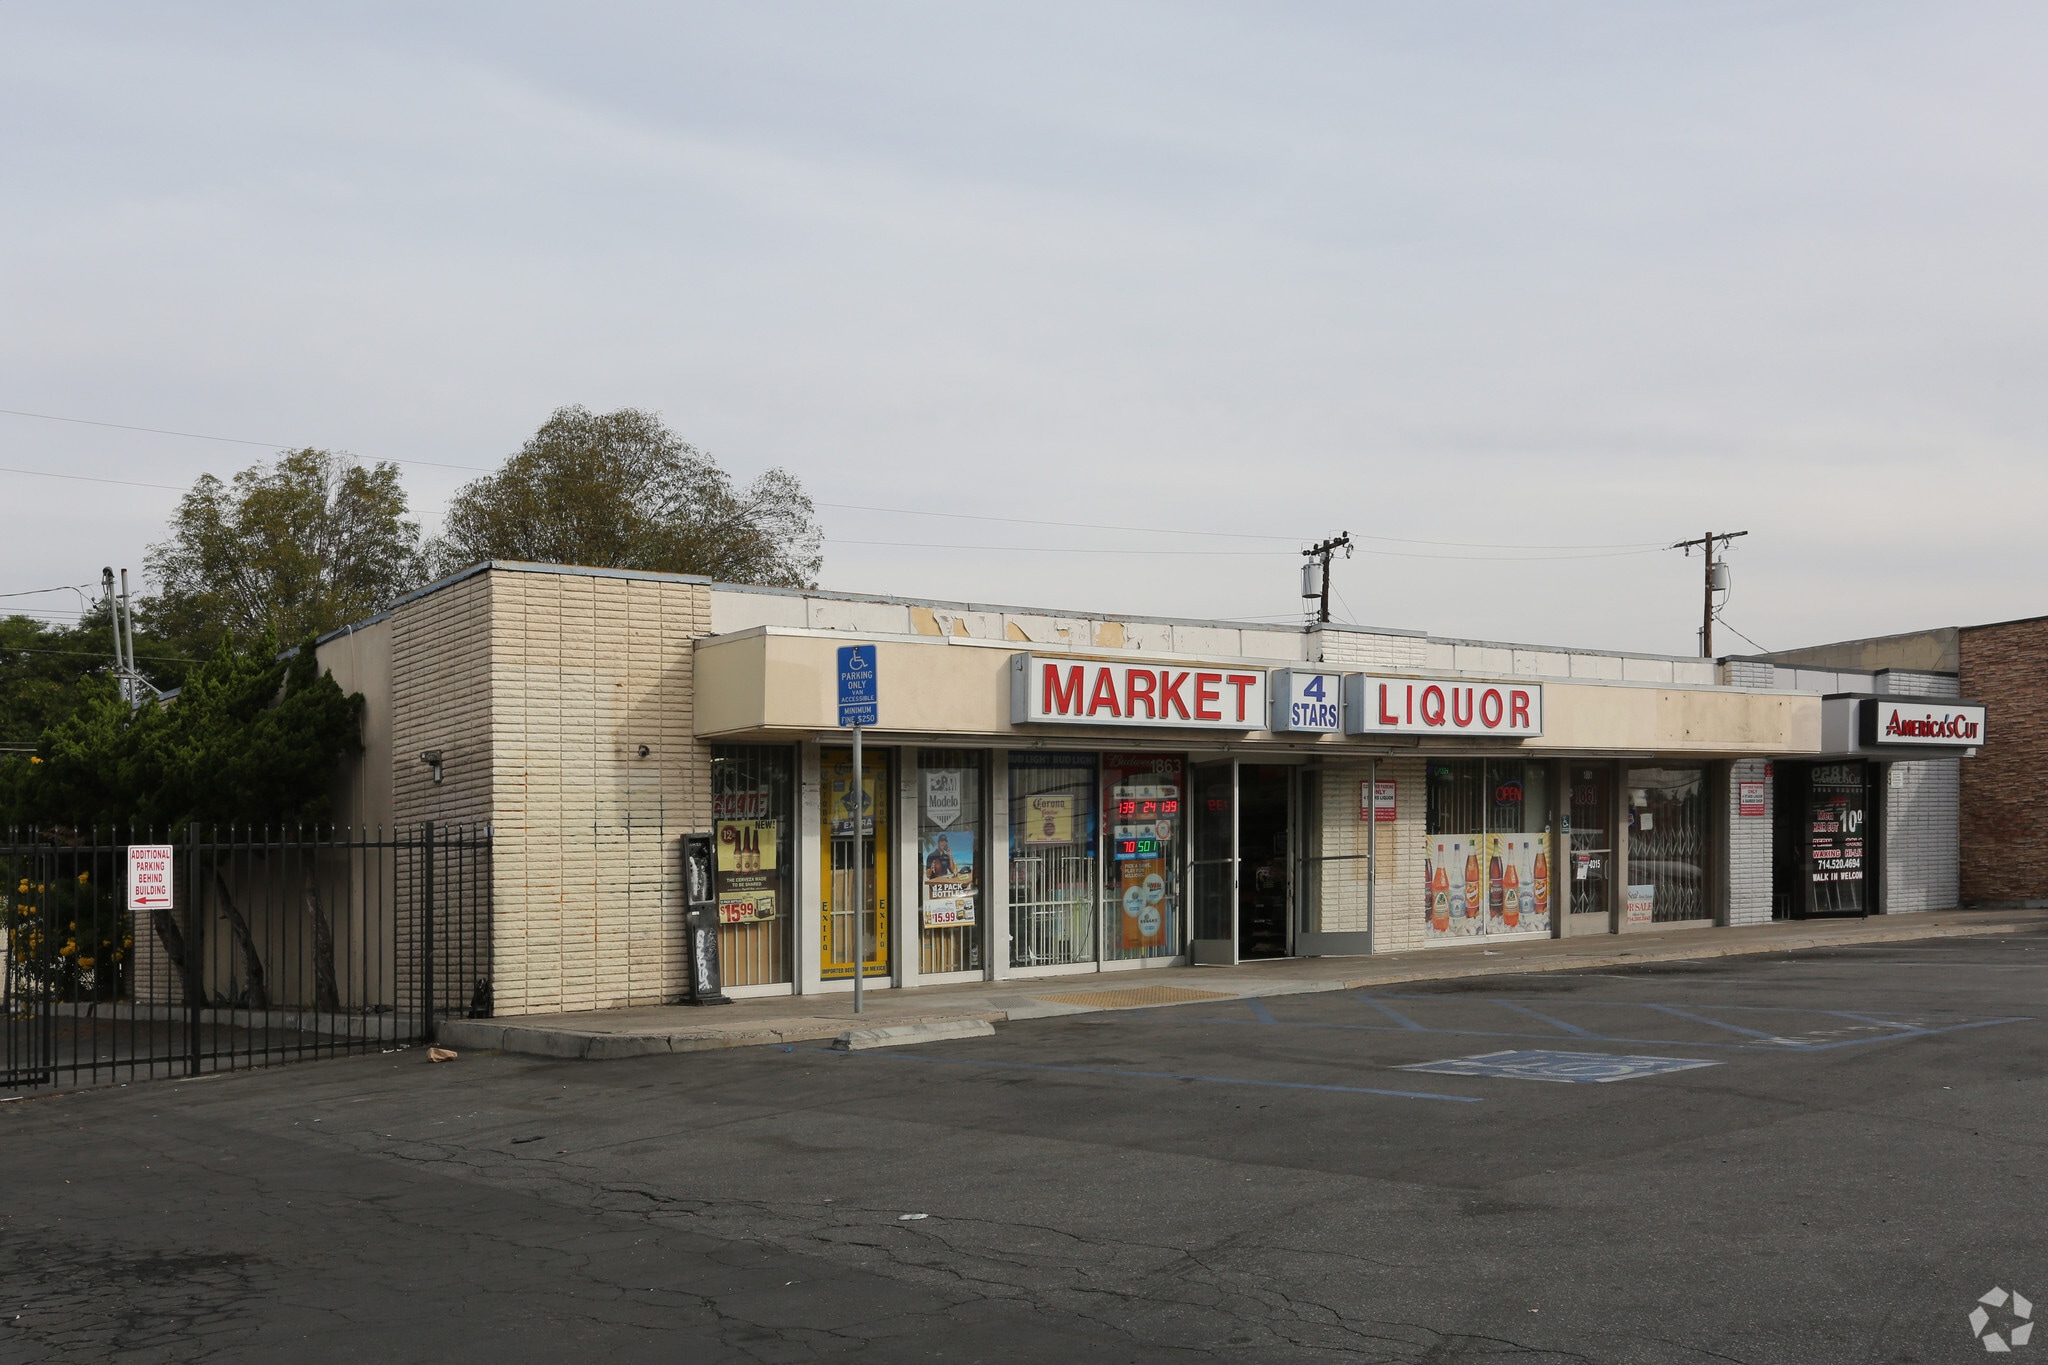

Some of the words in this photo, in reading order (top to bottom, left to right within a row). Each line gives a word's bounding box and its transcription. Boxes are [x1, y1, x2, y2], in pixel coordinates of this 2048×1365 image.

[841, 671, 873, 681] PARKING
[847, 681, 867, 690] ONLY
[1303, 675, 1327, 703] 4
[1042, 663, 1257, 722] MARKET
[841, 695, 875, 703] ACCESSIBLE
[844, 706, 872, 715] MINIMUM
[1379, 682, 1531, 729] LIQUOR
[841, 715, 855, 724] FINE
[857, 715, 875, 723] $250
[1291, 702, 1338, 728] STARS
[1151, 758, 1182, 774] 1863
[1495, 786, 1523, 801] OPEN
[1575, 785, 1598, 805] 1861
[928, 795, 959, 808] Modelo
[1033, 798, 1065, 811] Corona
[1119, 801, 1136, 814] 139
[1142, 801, 1157, 813] 24
[1161, 800, 1178, 813] 139
[1817, 810, 1834, 820] Men
[755, 820, 776, 830] NEW!
[843, 819, 873, 829] EXRA
[1827, 822, 1839, 832] CUT
[723, 829, 733, 840] 12
[1123, 841, 1137, 853] 70
[131, 849, 170, 859] ADDITIONAL
[136, 862, 165, 871] PARKING
[1818, 858, 1861, 870] 714.520.4694
[138, 873, 163, 883] BEHIND
[1812, 873, 1829, 882] WALK
[1830, 872, 1838, 881] IN
[135, 885, 166, 895] BUILDING
[944, 883, 963, 891] PACK
[932, 890, 965, 898] BOTTLES
